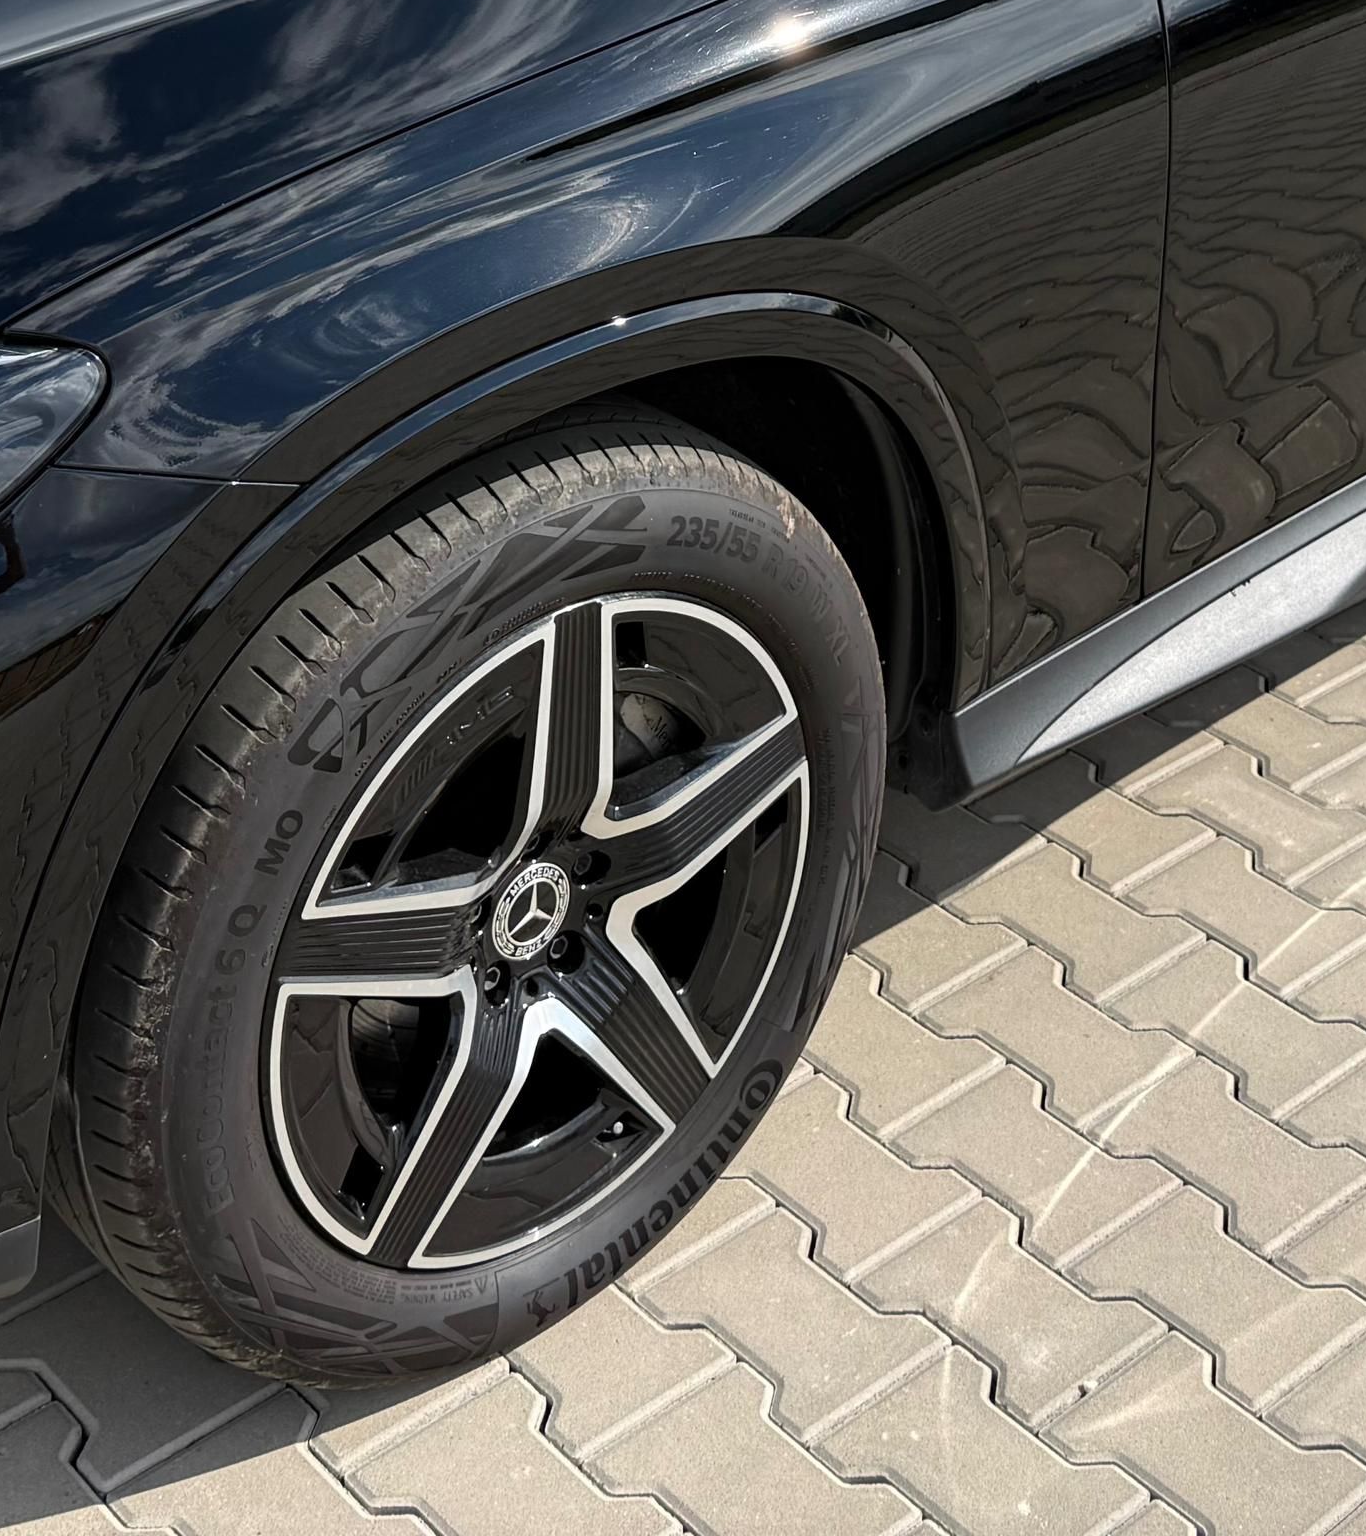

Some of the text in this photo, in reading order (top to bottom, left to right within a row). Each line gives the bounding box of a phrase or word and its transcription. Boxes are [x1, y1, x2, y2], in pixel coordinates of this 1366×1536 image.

[666, 515, 761, 563] 235/55
[761, 543, 784, 577] R
[254, 808, 304, 876] MO
[509, 866, 561, 897] MERCEDES
[227, 903, 267, 938] Q
[215, 947, 246, 977] 6
[514, 939, 543, 957] BENZ
[563, 1058, 784, 1309] Continental
